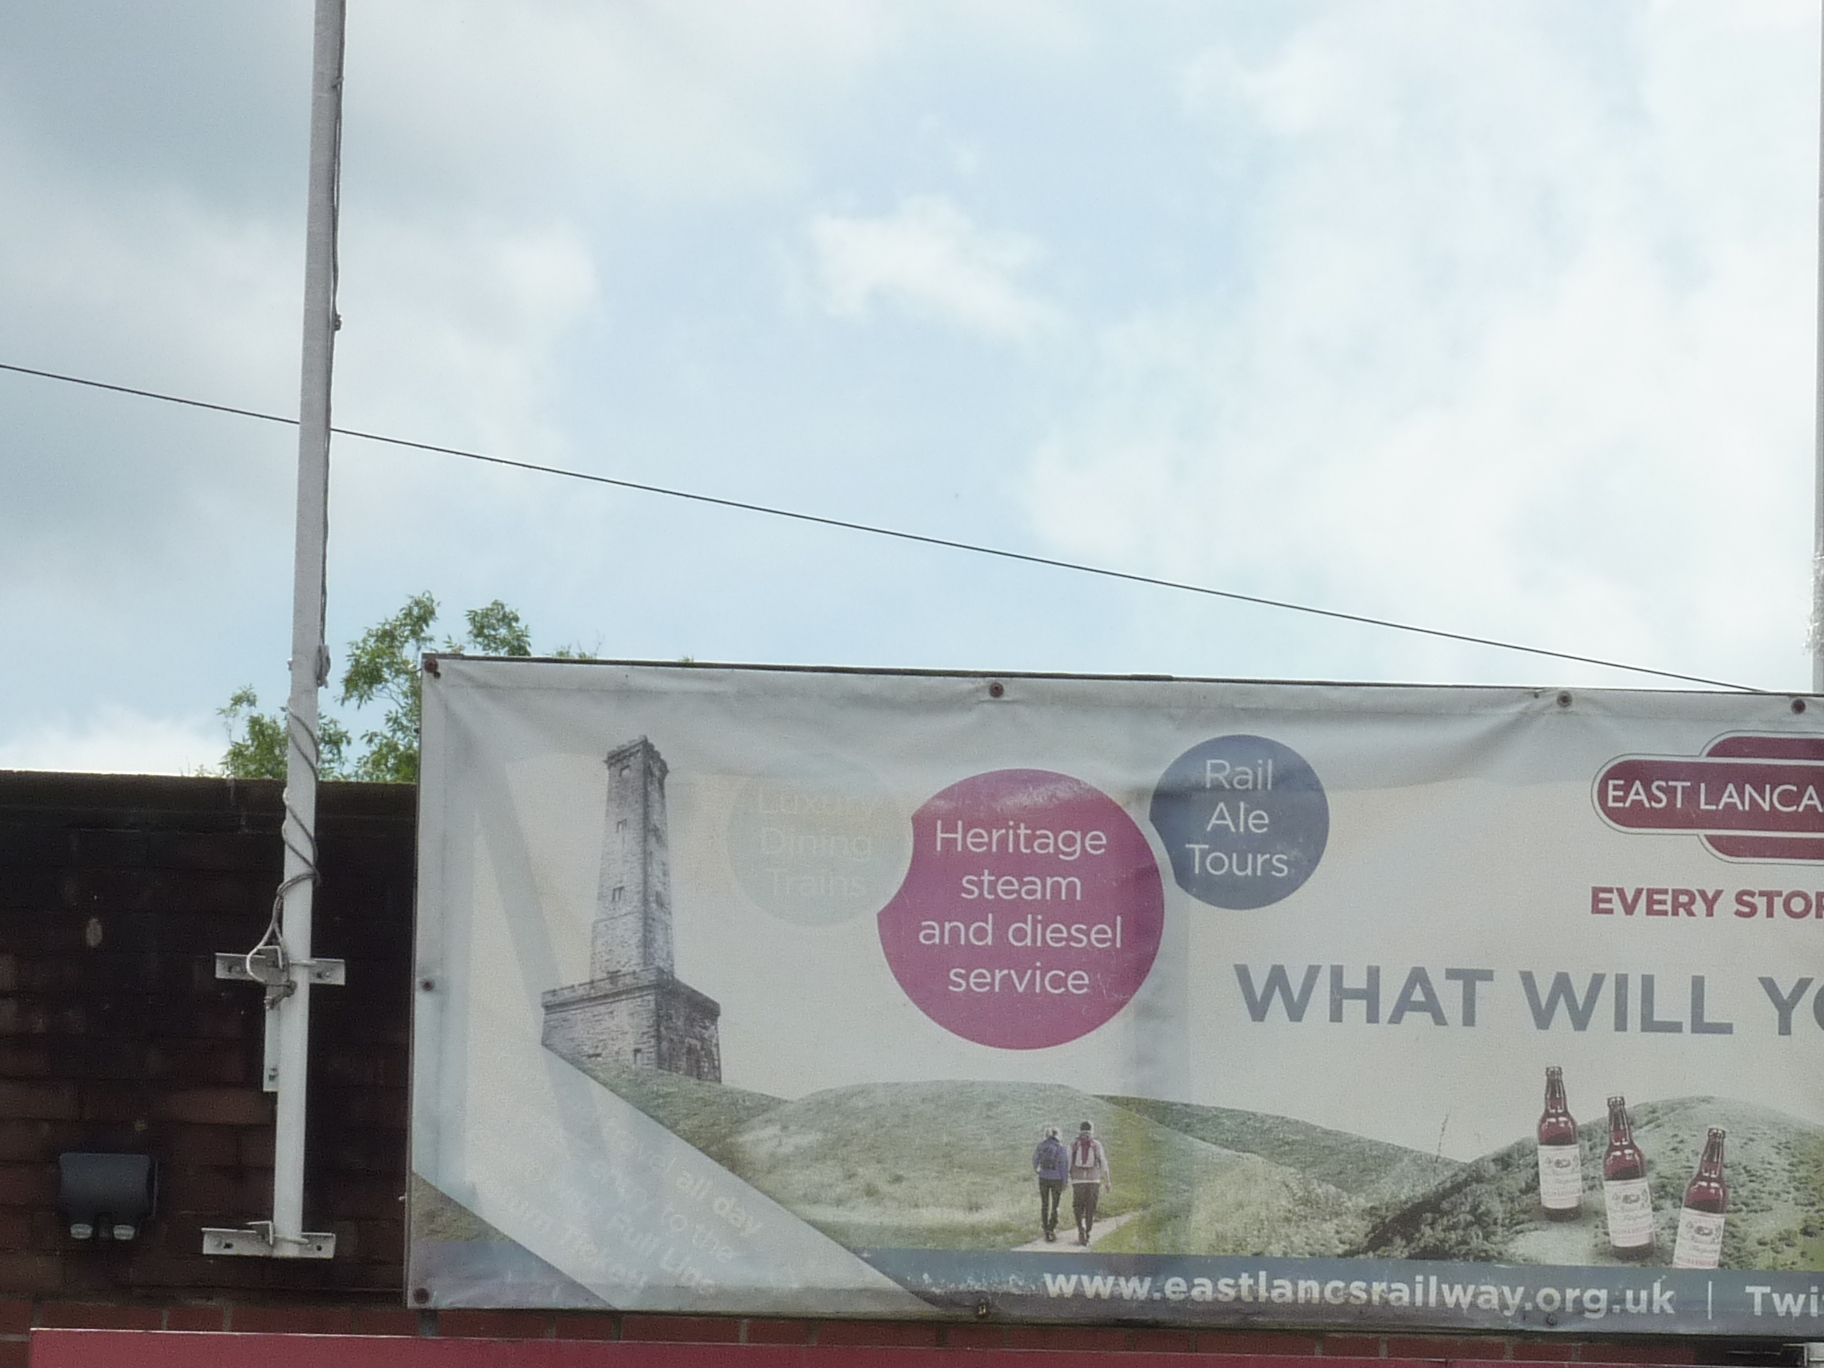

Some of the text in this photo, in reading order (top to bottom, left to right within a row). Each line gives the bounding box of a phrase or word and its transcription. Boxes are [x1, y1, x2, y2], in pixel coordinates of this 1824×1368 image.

[1205, 758, 1274, 791] Rail
[1606, 779, 1692, 810] EAST
[1205, 802, 1270, 834] Ale
[935, 819, 1108, 861] Heritage
[1185, 843, 1289, 877] Tours
[960, 871, 1082, 901] steam
[1590, 886, 1725, 918] EVERY
[917, 912, 1124, 949] and diesel
[947, 961, 1091, 996] service
[1233, 963, 1495, 1028] WHAT
[1518, 970, 1735, 1036] WILL
[1043, 1269, 1676, 1319] www.eastlancsrailway.org.uk
